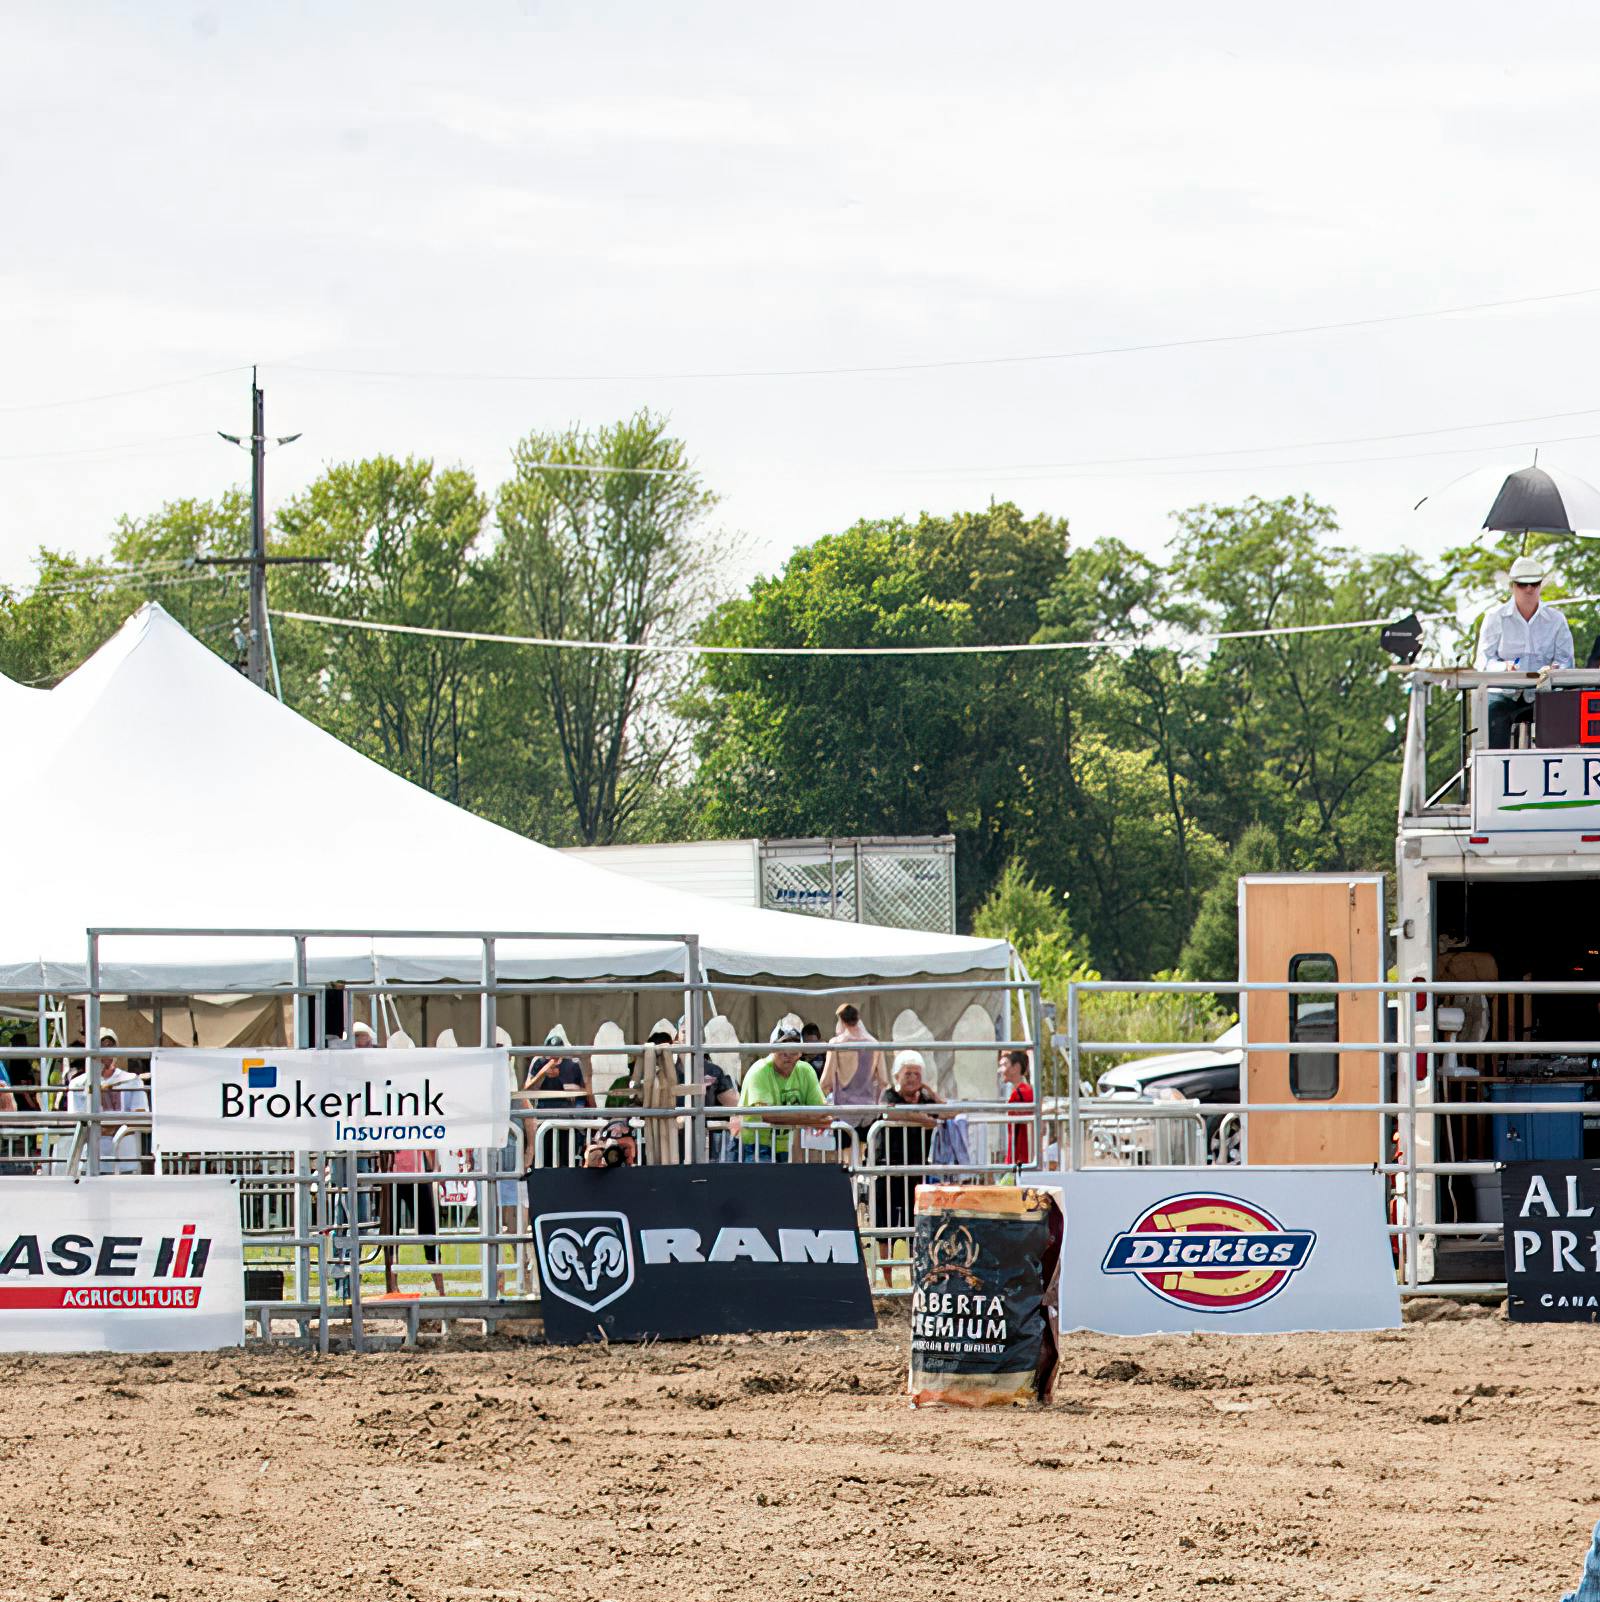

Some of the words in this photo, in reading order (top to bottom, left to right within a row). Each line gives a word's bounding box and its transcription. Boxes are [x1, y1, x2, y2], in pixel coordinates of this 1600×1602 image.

[222, 1079, 445, 1118] BrokerLink
[336, 1121, 446, 1141] Insurance
[0, 1234, 143, 1277] ASE
[640, 1227, 859, 1264] RAM
[1125, 1239, 1295, 1264] Dickies
[62, 1289, 196, 1307] AGRICULTURE
